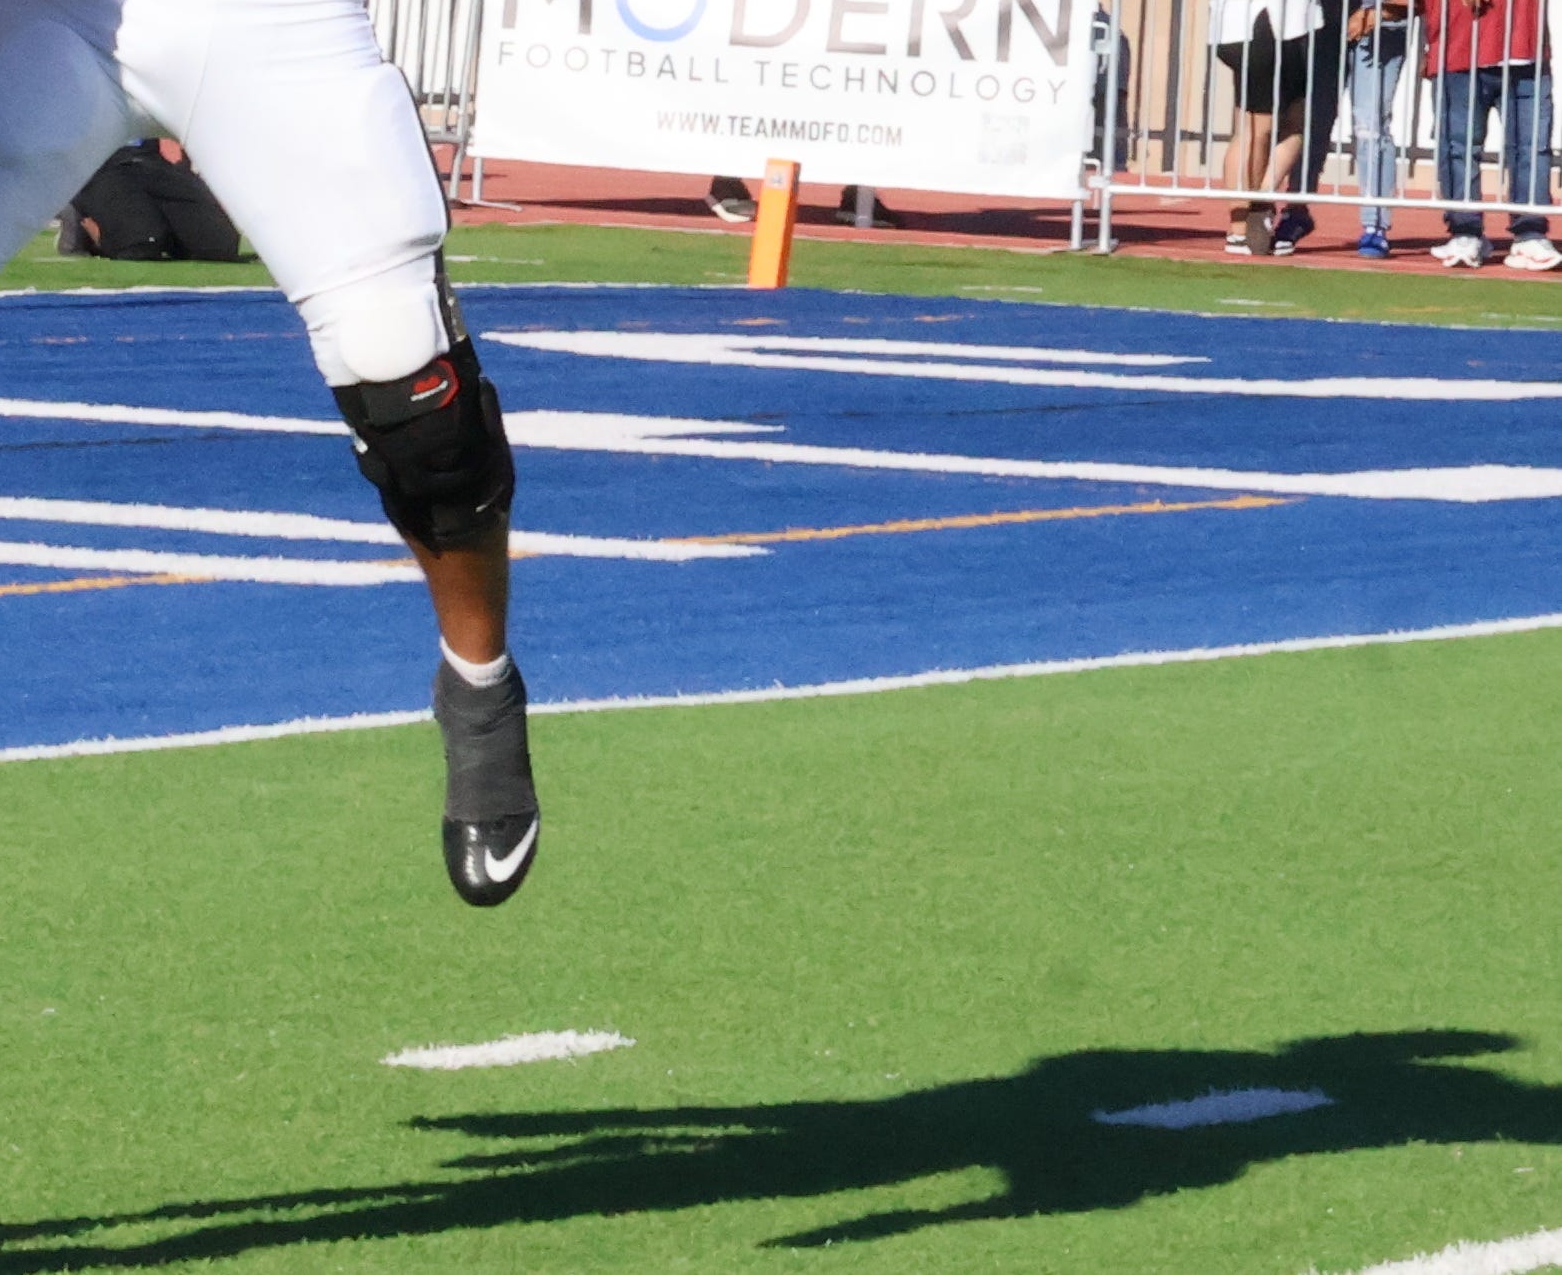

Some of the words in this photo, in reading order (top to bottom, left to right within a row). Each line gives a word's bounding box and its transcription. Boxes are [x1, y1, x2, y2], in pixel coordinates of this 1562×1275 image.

[498, 41, 730, 84] FOOTBALL
[754, 59, 1068, 105] TECHNOLOGY
[656, 110, 903, 147] WWW.TEAMMOFO.COM
